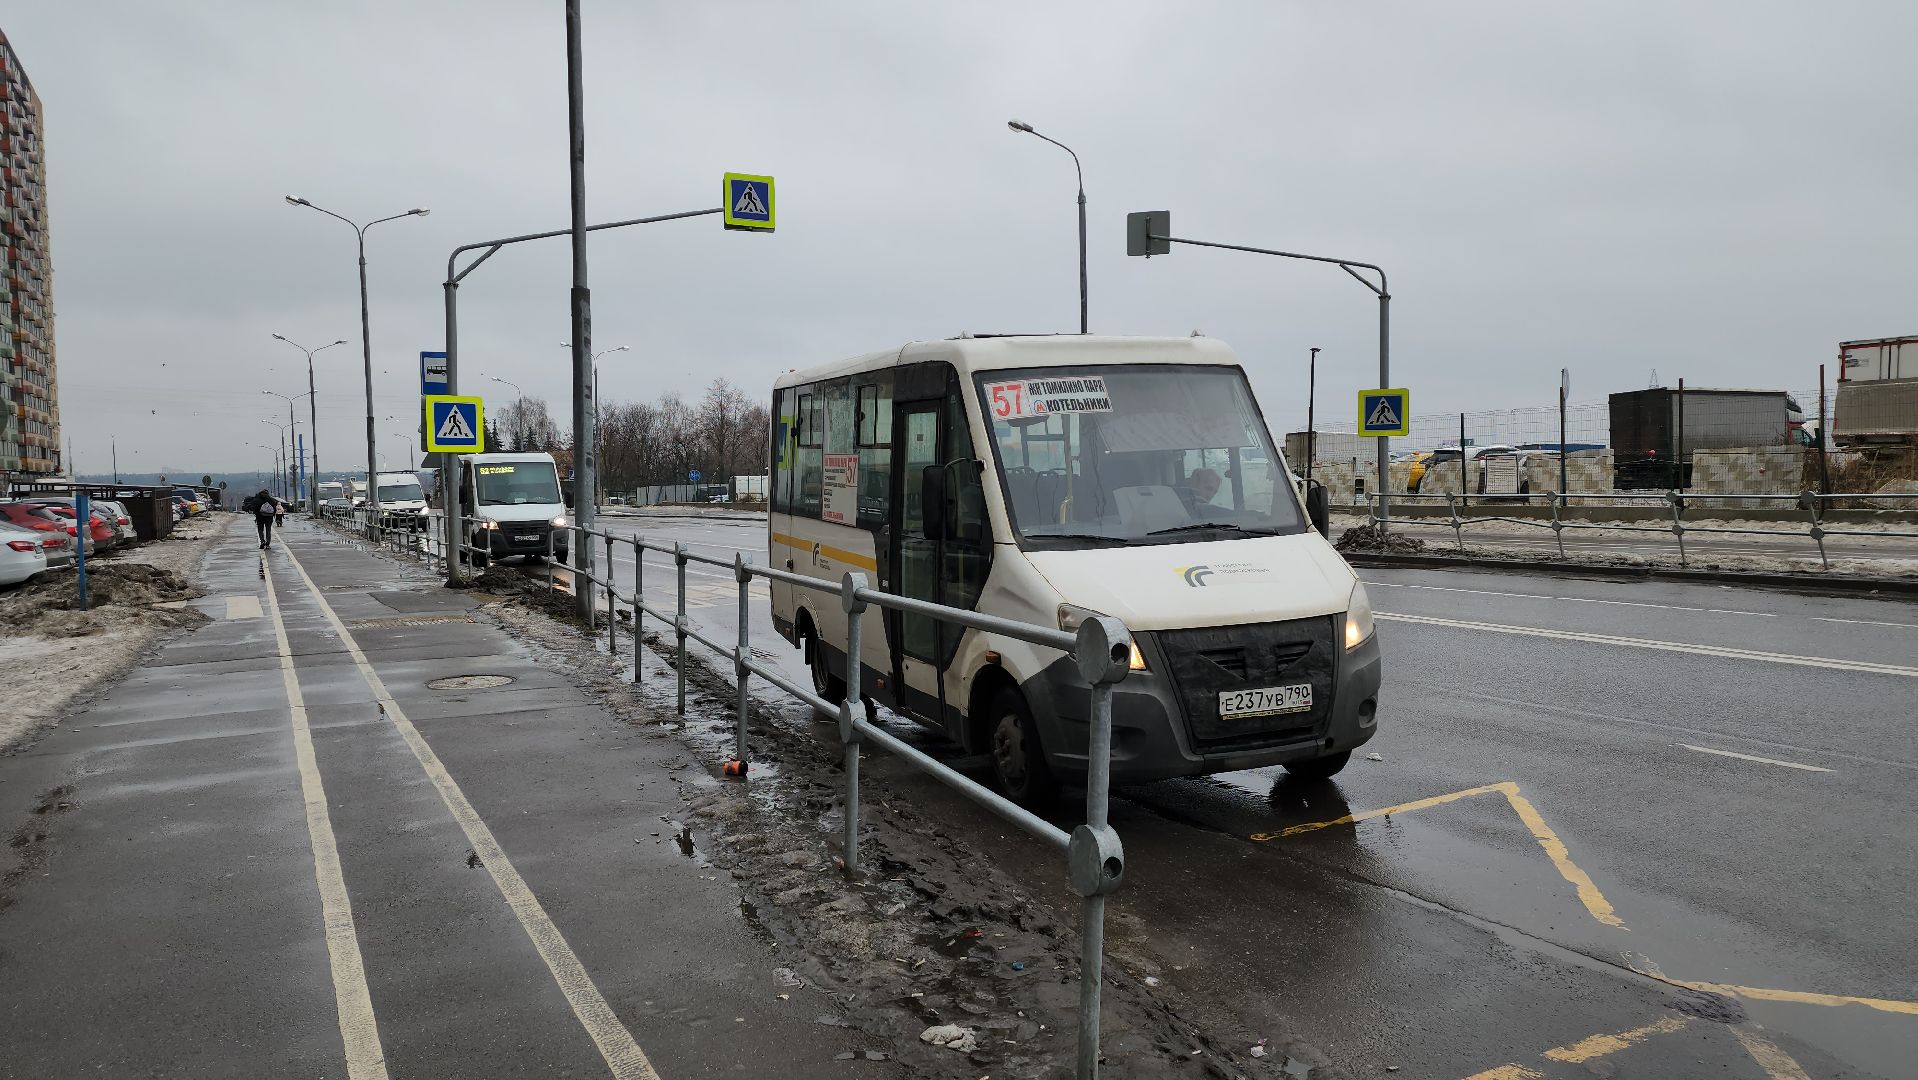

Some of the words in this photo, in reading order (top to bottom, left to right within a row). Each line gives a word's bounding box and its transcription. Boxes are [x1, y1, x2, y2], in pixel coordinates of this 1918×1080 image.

[1042, 380, 1084, 395] ТОМИЛИНО
[1084, 379, 1105, 393] ПАРК
[991, 384, 1022, 417] 57
[1046, 397, 1111, 412] КОТЕЛЬНИКИ
[847, 457, 858, 484] 57
[1225, 691, 1284, 711] Е237УВ
[1286, 685, 1310, 701] 790
